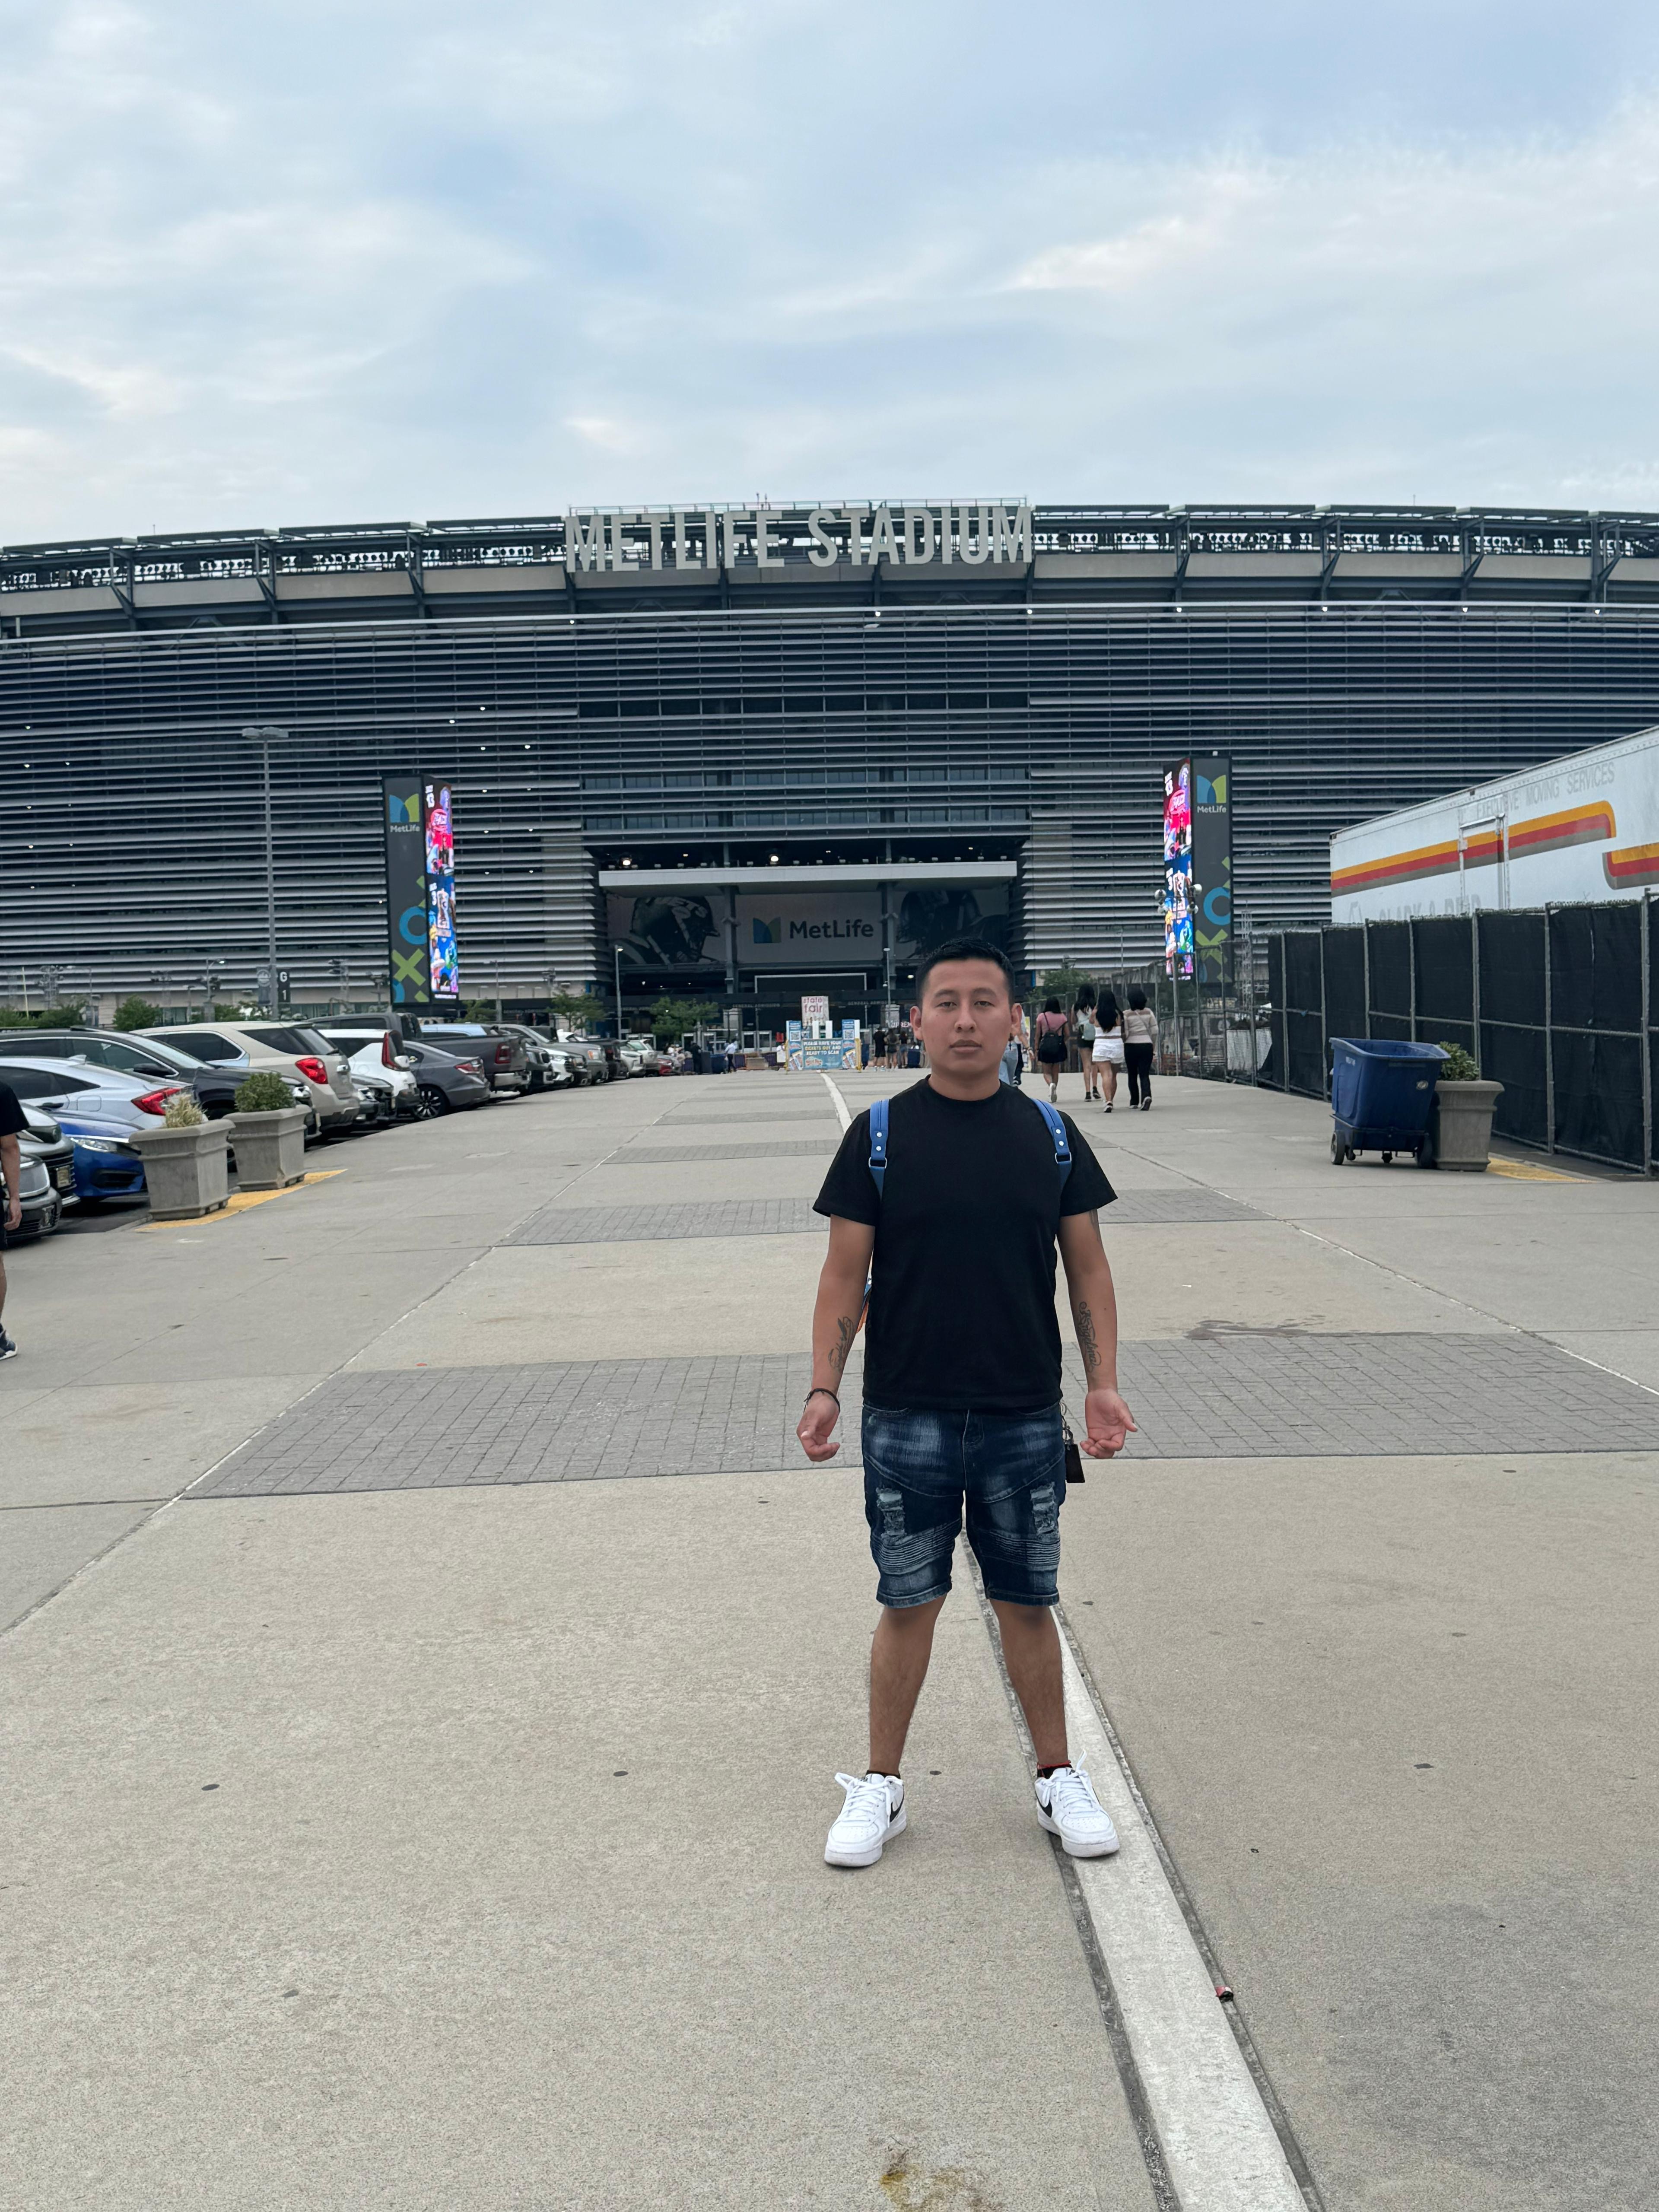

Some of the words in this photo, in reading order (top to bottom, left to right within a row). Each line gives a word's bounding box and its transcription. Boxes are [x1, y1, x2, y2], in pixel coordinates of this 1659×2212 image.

[565, 510, 785, 572] METLIFE
[807, 506, 1033, 567] STADIUM
[1477, 791, 1519, 818] EXECUTVE
[1526, 778, 1560, 806] MOVING
[1567, 762, 1615, 794] SERVICES
[390, 824, 420, 833] MetLife
[790, 919, 874, 939] MetLife
[280, 972, 287, 982] G
[282, 990, 286, 1000] 1
[804, 1004, 822, 1014] fair
